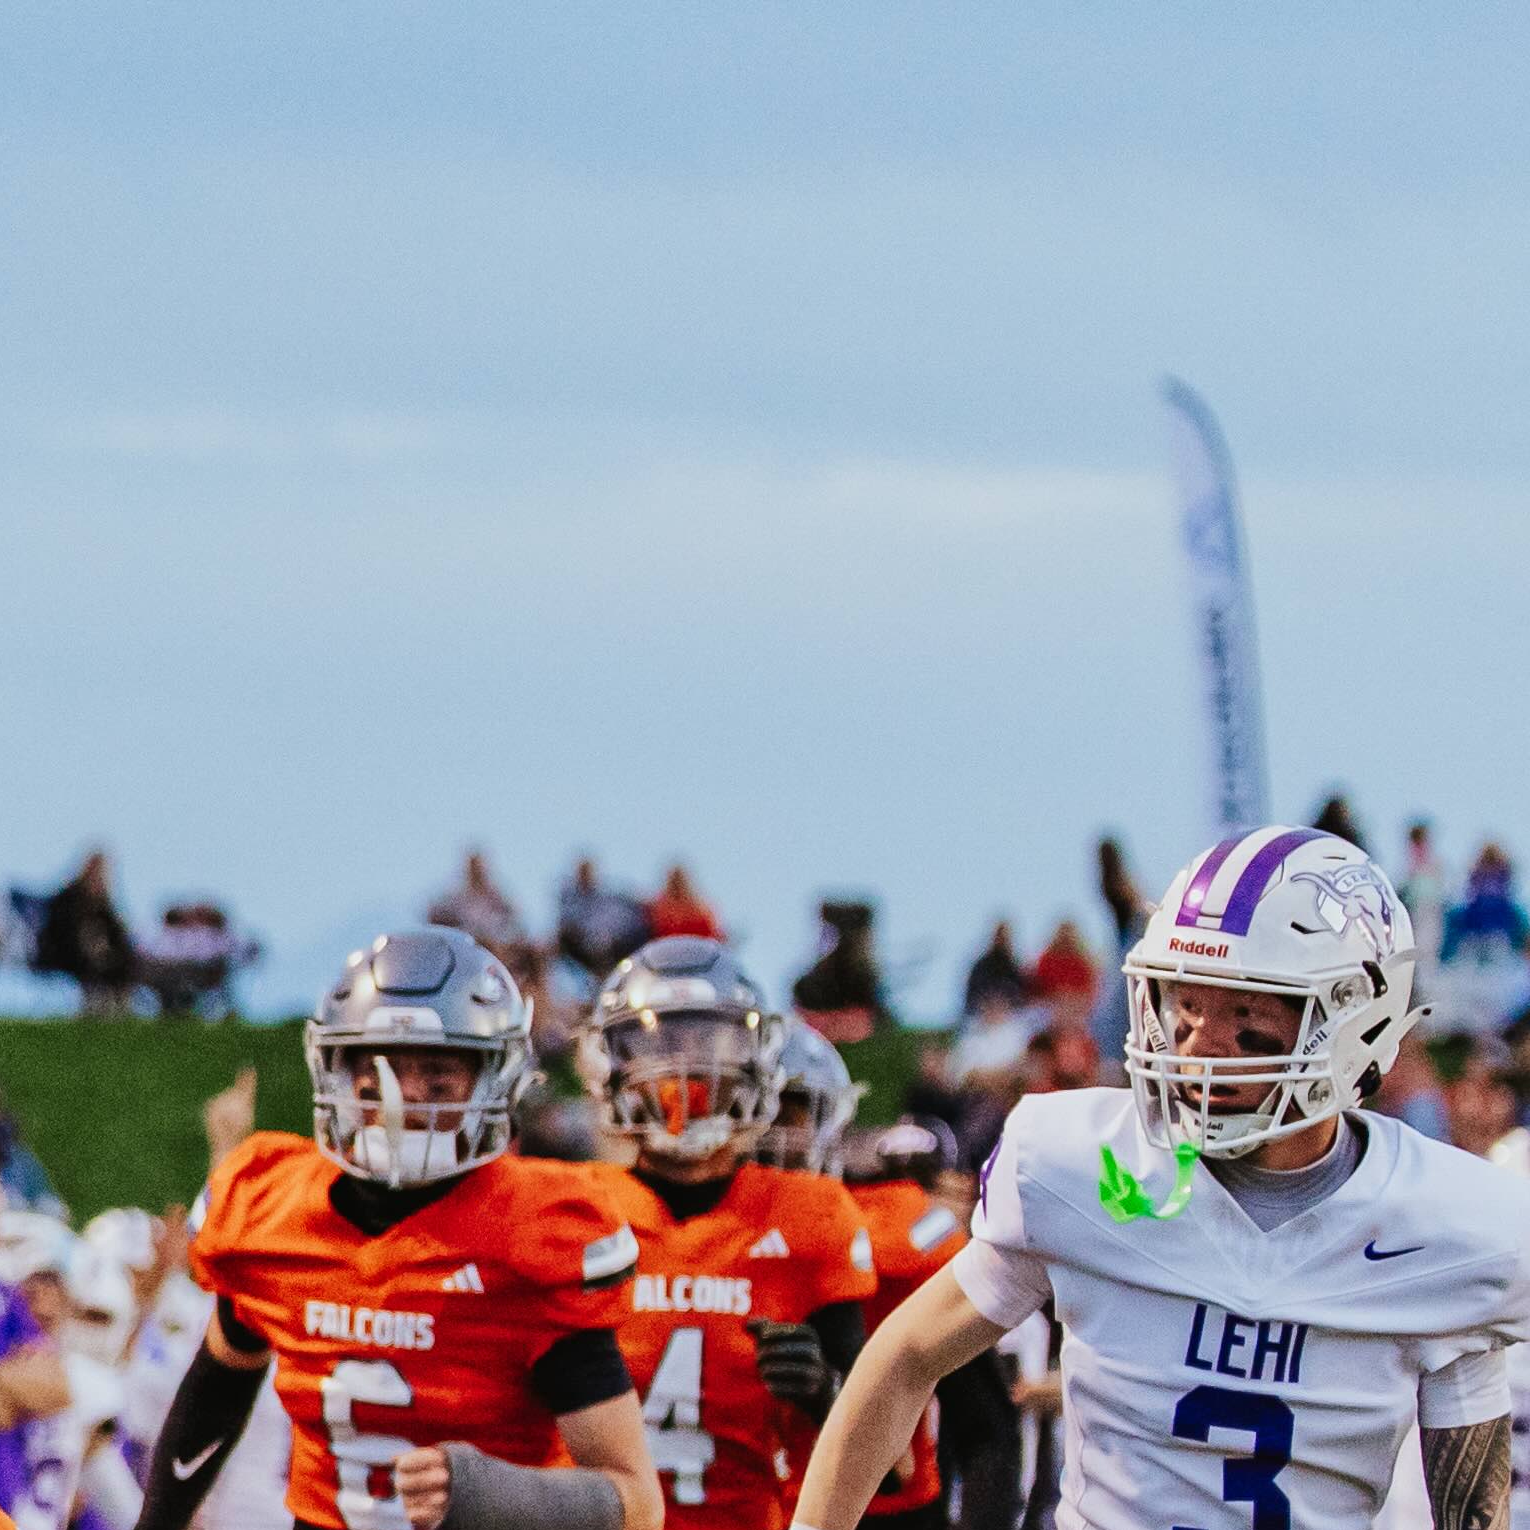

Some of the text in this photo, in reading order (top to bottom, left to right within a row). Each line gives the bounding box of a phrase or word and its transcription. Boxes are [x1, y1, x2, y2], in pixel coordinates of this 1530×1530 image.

[1169, 937, 1229, 958] Riddell
[633, 1274, 752, 1315] ALCONS
[305, 1300, 435, 1350] FALCONS
[1185, 1303, 1308, 1383] LEHI
[642, 1326, 716, 1505] 4
